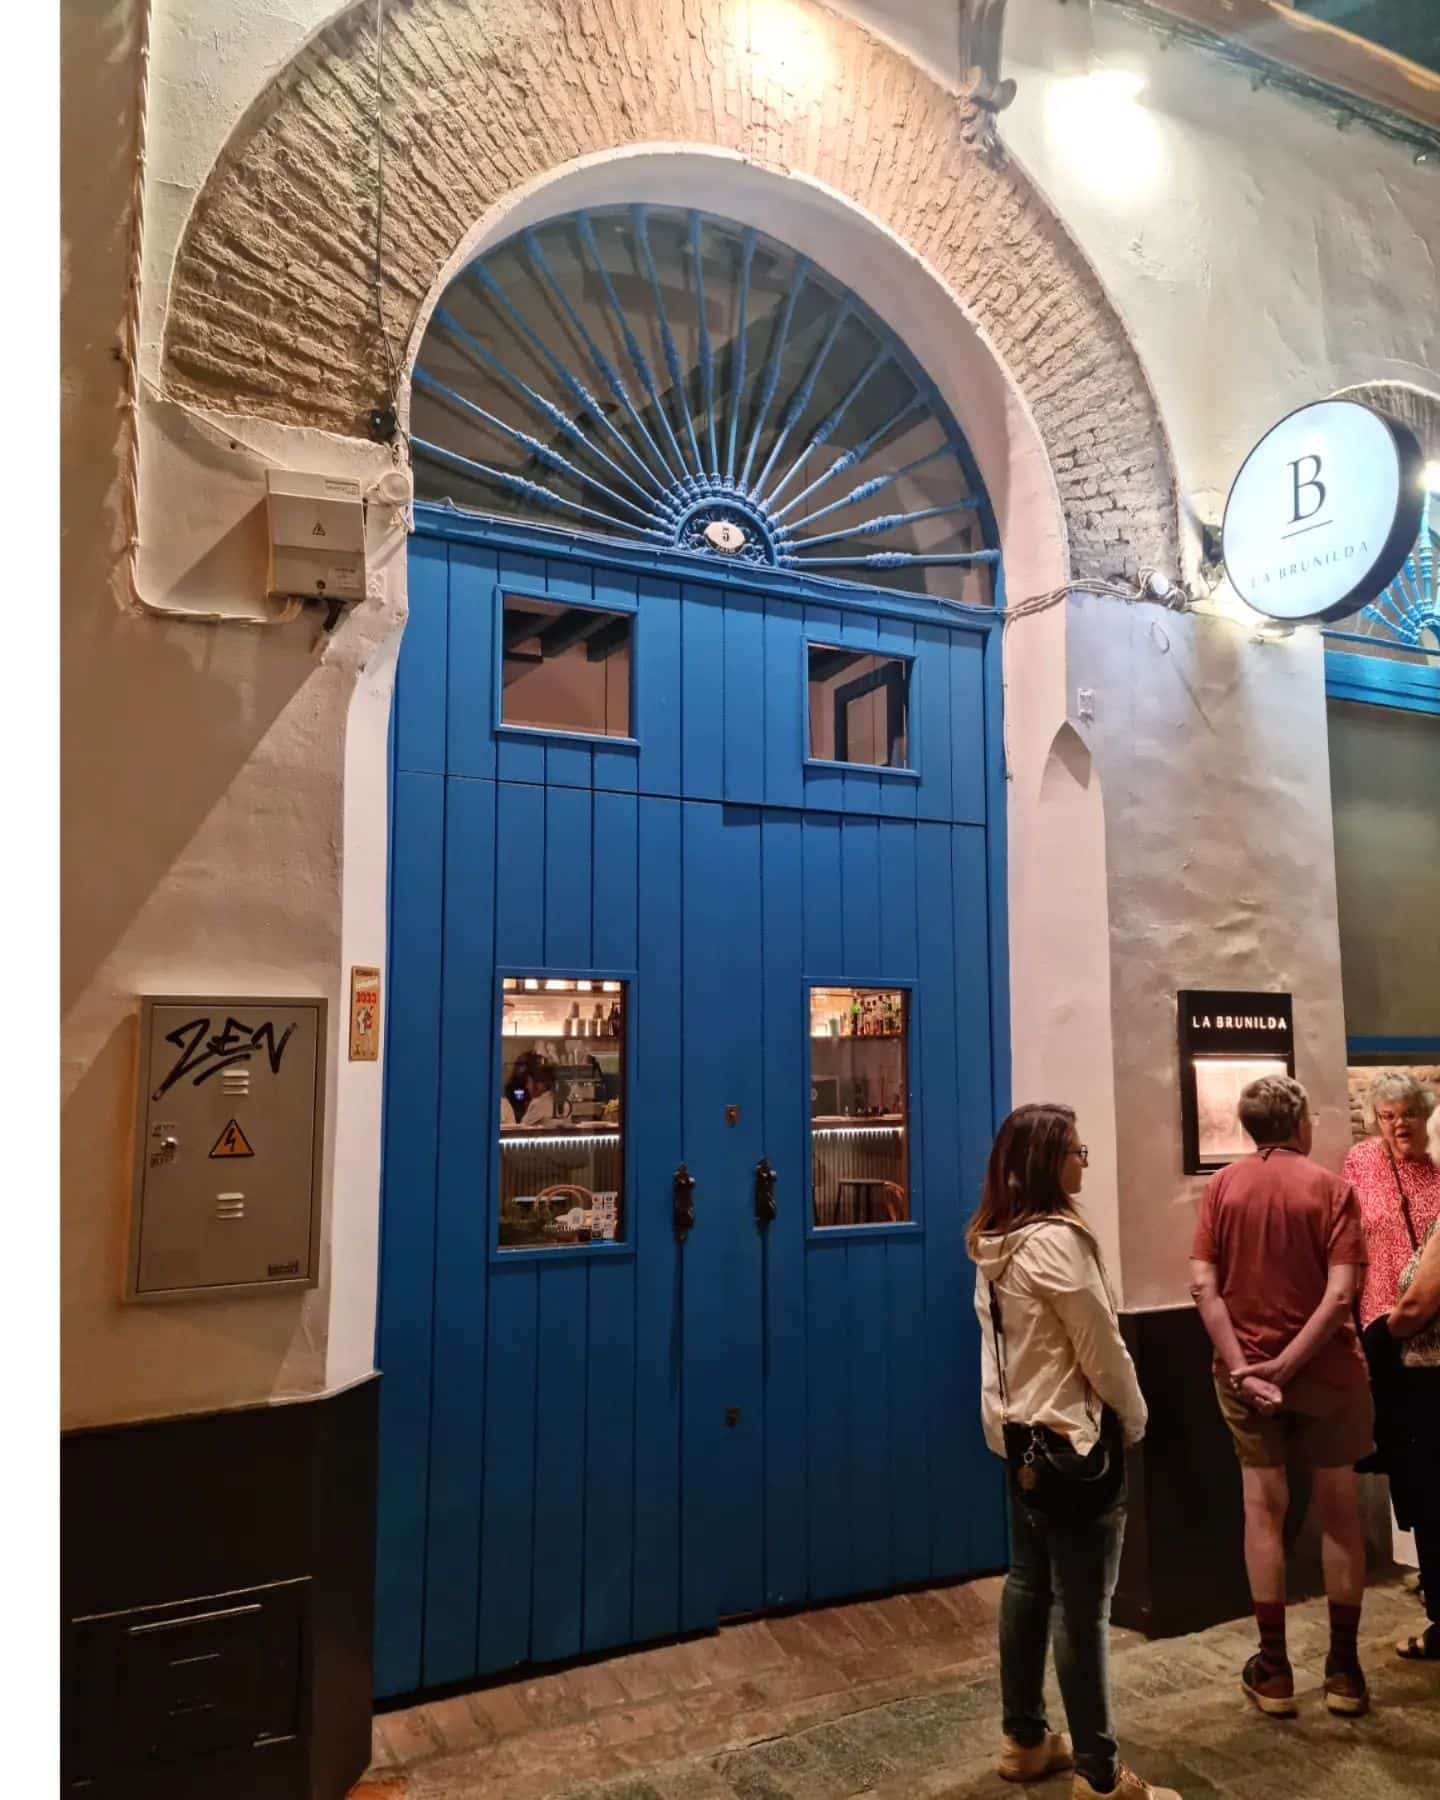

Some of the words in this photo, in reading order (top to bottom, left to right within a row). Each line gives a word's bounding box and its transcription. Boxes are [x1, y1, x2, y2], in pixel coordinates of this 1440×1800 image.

[1287, 454, 1325, 524] B
[1279, 541, 1369, 579] BRUNILDA
[1193, 1016, 1211, 1028] LA
[1216, 1016, 1287, 1029] BRUNILDA
